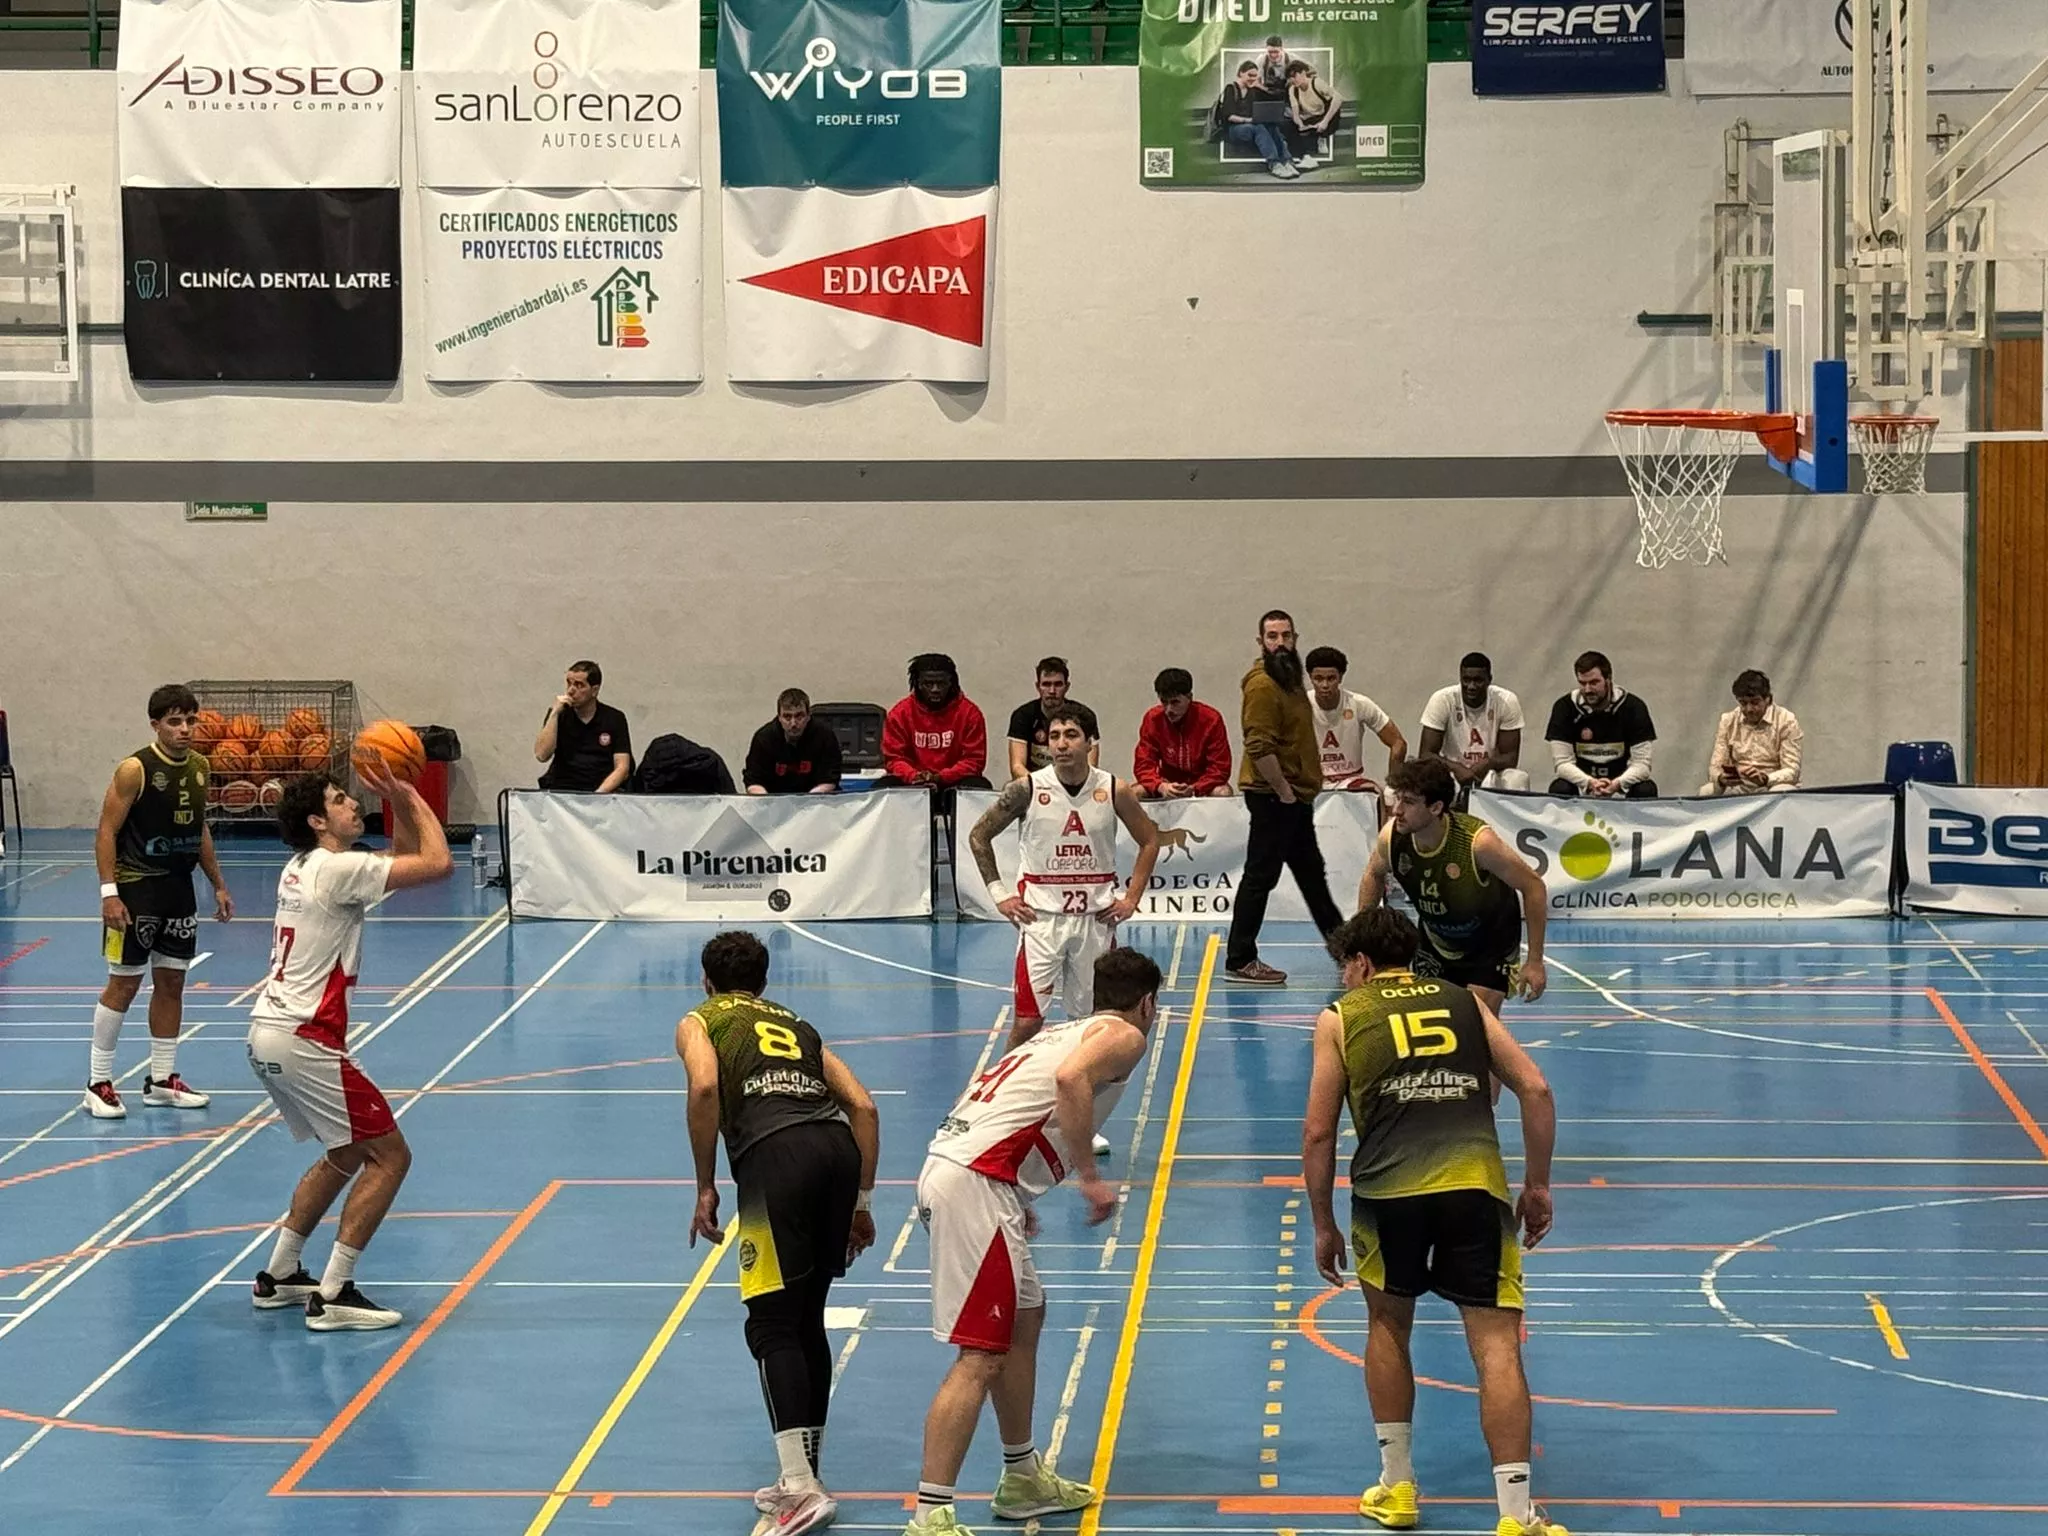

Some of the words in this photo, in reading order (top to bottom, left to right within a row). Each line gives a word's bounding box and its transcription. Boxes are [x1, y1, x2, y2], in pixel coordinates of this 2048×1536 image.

[1281, 8, 1314, 22] más
[1317, 9, 1378, 21] cercana
[1483, 3, 1652, 36] SERFEY
[128, 55, 384, 107] ADISSEO
[164, 101, 173, 110] A
[188, 101, 279, 111] Bluestar
[293, 101, 384, 112] Company
[435, 85, 682, 121] sanLorenzo
[816, 115, 863, 126] PEOPLE
[866, 114, 901, 126] FIRST
[542, 133, 682, 149] AUTOESCUELA
[439, 212, 560, 233] CERTIFICADOS
[565, 209, 678, 233] ENERGÉTICOS
[462, 240, 558, 260] PROYECTOS
[563, 237, 664, 260] ELÉCTRICOS
[260, 272, 330, 289] DENTAL
[335, 272, 391, 289] LATRE
[823, 265, 970, 295] EDIGAPA
[179, 791, 190, 806] 2
[1062, 810, 1087, 836] A
[1055, 845, 1093, 857] LETRA
[637, 850, 674, 875] La
[682, 848, 827, 876] Pirenaica
[1113, 872, 1233, 890] DEGA
[1420, 881, 1441, 899] 14
[1062, 890, 1088, 914] 23
[1551, 890, 1639, 909] CLÍNICA
[1647, 889, 1799, 908] PODOLÓGICA
[1381, 984, 1440, 999] OCHO
[754, 1020, 803, 1061] 8
[1388, 1009, 1458, 1059] 15
